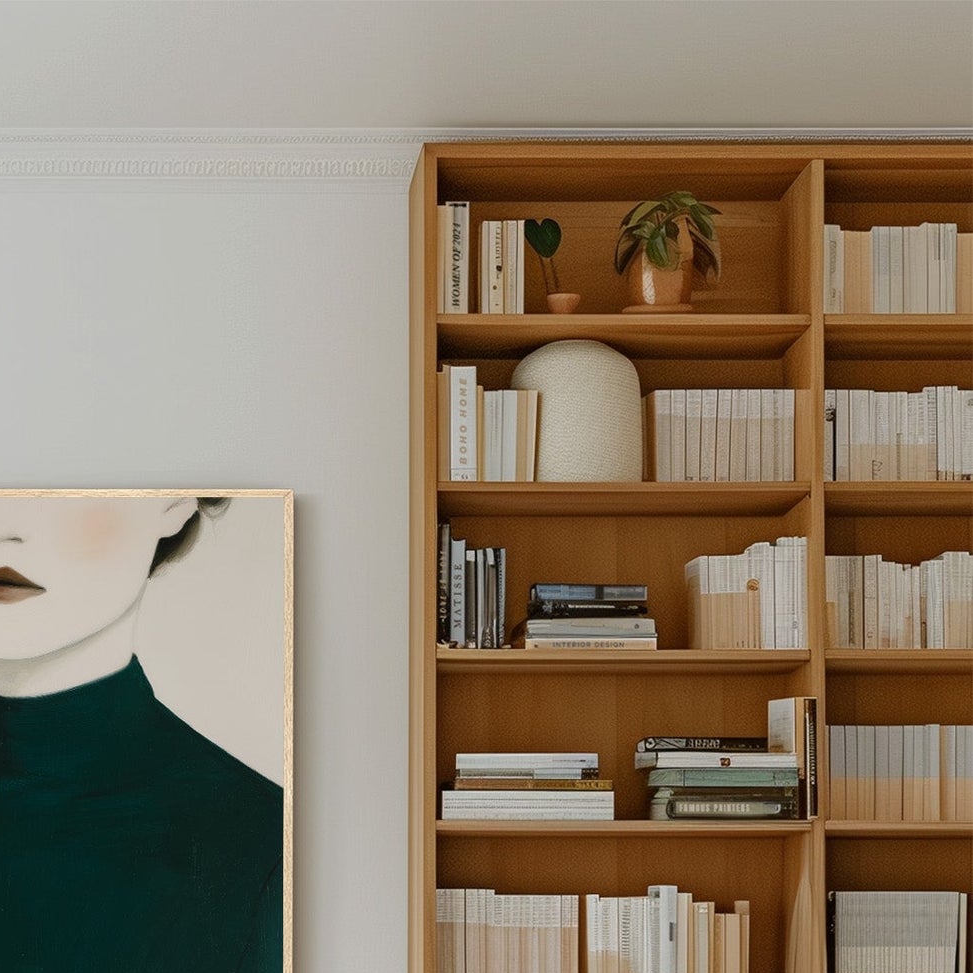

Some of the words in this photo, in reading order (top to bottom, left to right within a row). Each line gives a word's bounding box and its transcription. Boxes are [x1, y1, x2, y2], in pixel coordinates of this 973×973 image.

[452, 247, 461, 261] OF
[452, 263, 460, 307] WOMEN
[459, 378, 467, 418] HOME
[459, 425, 467, 465] BOHO
[453, 564, 462, 629] MATISSE
[678, 803, 711, 813] FAMOUS
[713, 803, 751, 813] PAINTERS
